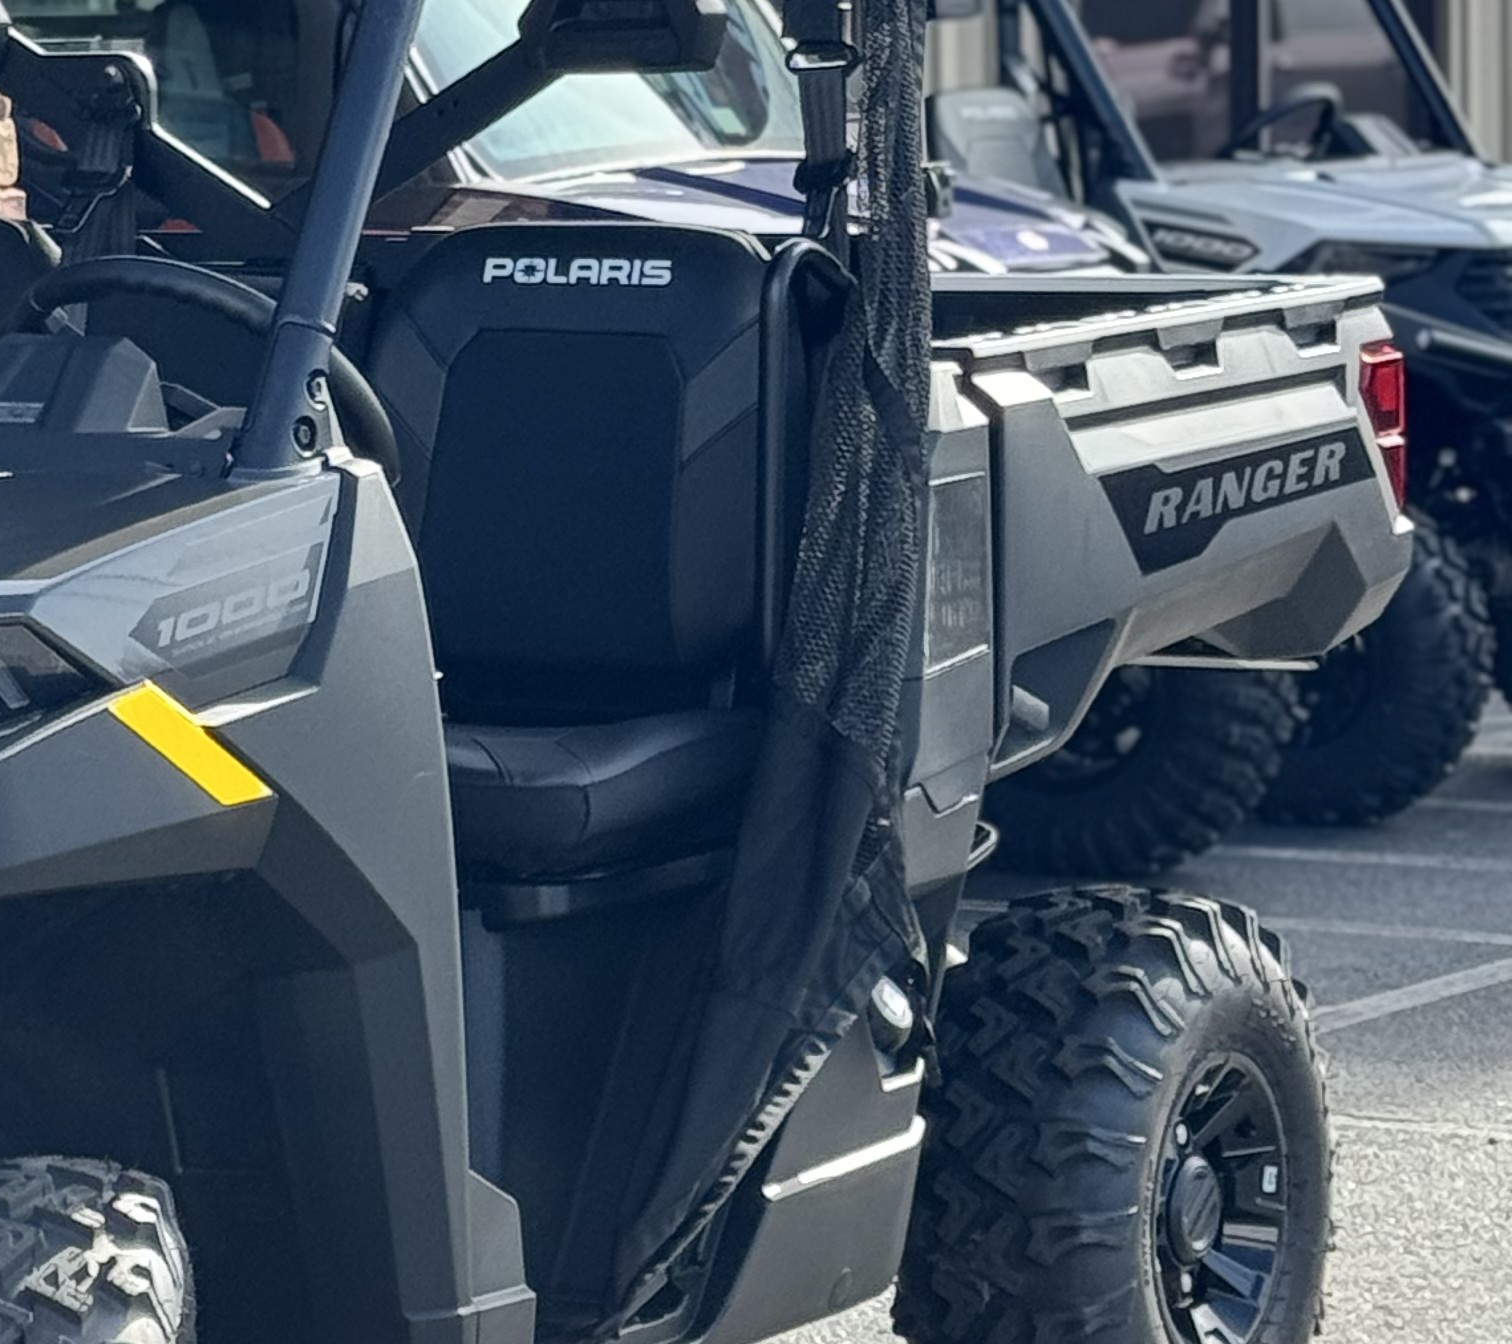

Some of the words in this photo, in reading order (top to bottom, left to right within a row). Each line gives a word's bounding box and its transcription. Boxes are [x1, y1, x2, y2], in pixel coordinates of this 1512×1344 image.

[1153, 229, 1254, 257] 1000
[483, 257, 672, 286] POLARIS
[1144, 442, 1345, 533] RANGER
[157, 570, 310, 647] 1000
